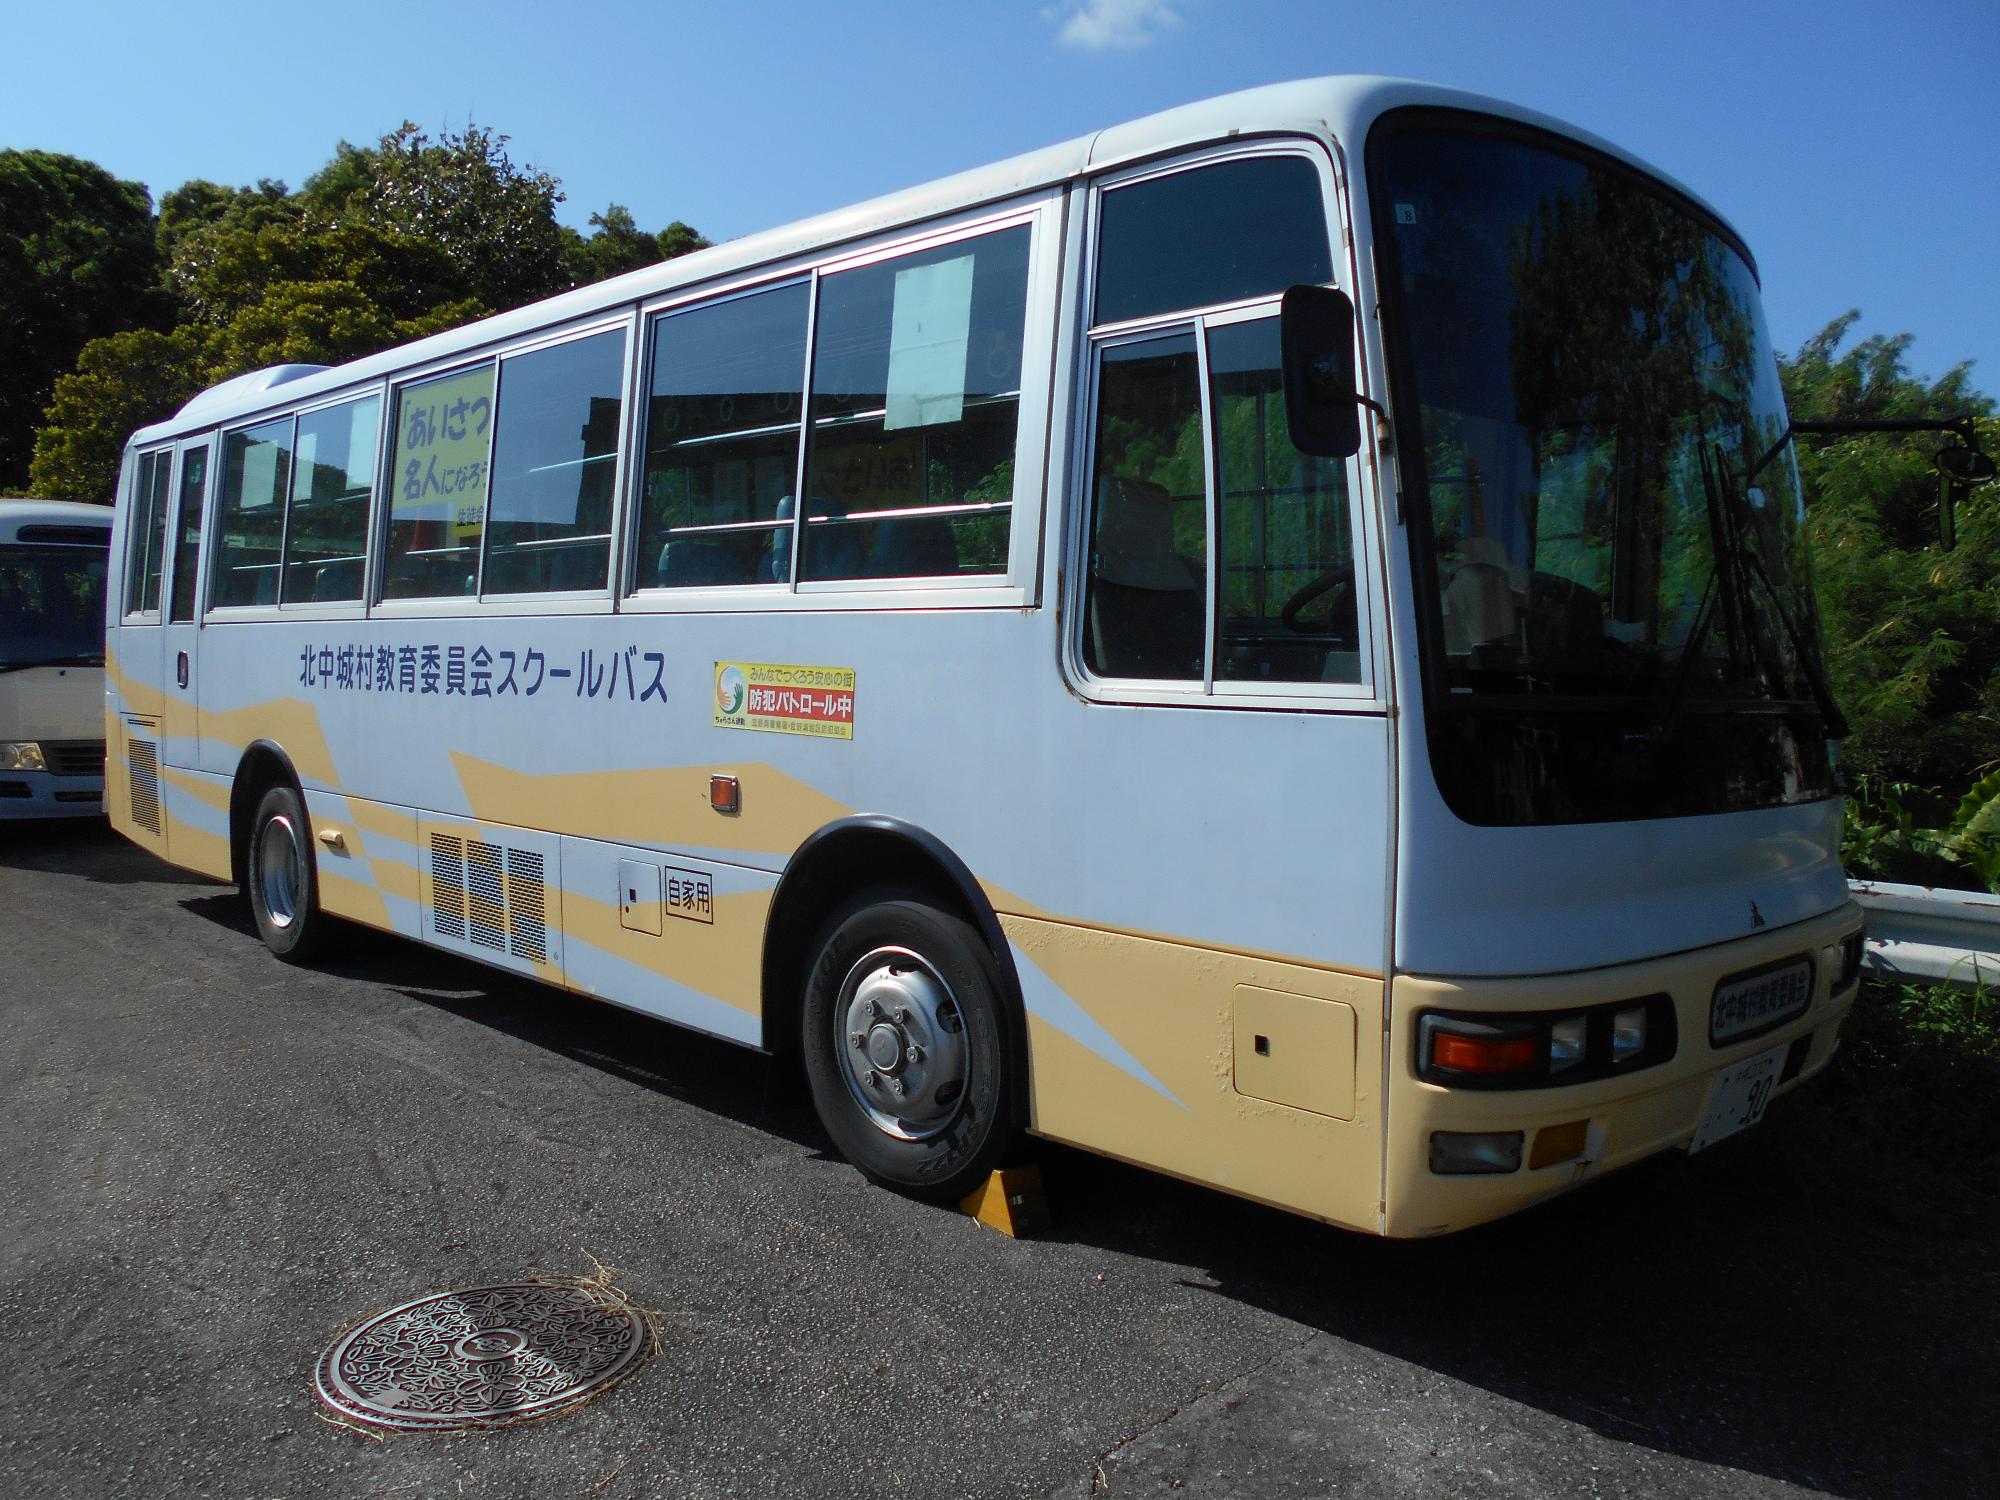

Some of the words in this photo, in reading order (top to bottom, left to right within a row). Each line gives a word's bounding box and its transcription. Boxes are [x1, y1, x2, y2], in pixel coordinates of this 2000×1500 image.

[300, 644, 668, 704] 北中城村教育委員会スクールバス
[750, 667, 853, 687] みんなでつくろう安心の街
[750, 689, 852, 718] 防犯パトロール中
[669, 875, 710, 914] 自家用
